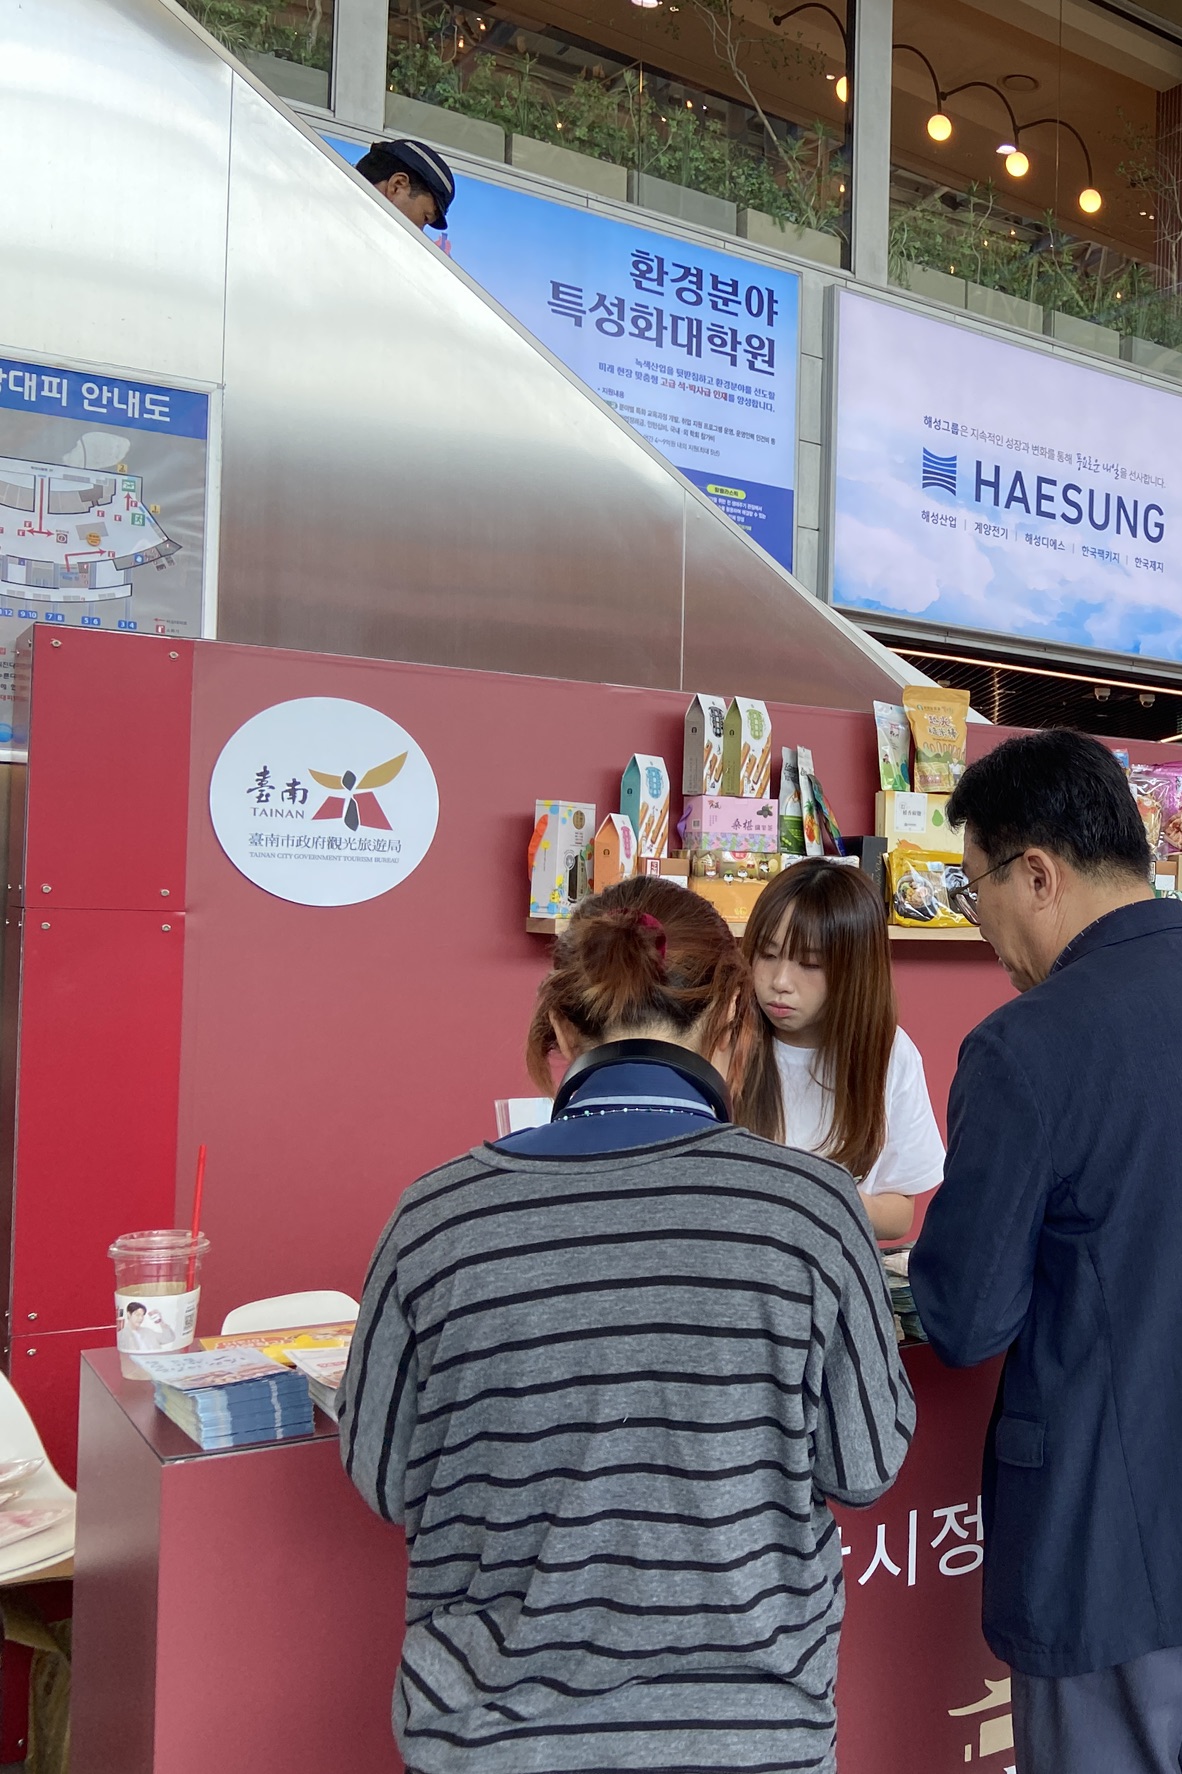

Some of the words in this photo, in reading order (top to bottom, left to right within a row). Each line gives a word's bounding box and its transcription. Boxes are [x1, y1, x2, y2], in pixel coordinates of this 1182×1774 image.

[630, 249, 778, 327] 환경분야
[547, 280, 775, 376] 특성화대학원
[81, 382, 171, 422] 안내도
[598, 362, 615, 374] 미래
[617, 366, 633, 378] 현장
[635, 371, 659, 385] 맞춤형
[660, 377, 676, 389] 고급
[678, 381, 711, 397] 석·박사급
[713, 389, 735, 403] 인재를
[737, 395, 775, 413] 양성합니다.
[602, 387, 625, 399] 지원내용
[635, 358, 674, 376] 녹색산업을
[676, 368, 714, 386] 뒷받침하고
[716, 378, 752, 395] 환경분야를
[754, 387, 775, 400] 선도할
[923, 414, 969, 438] 해성그룹은
[970, 427, 1004, 448] 지속적인
[1005, 436, 1030, 454] 성장과
[1031, 443, 1055, 461] 변화를
[1056, 450, 1073, 465] 통해
[1076, 451, 1101, 473] 풍요로운
[1102, 462, 1127, 481] 내일을
[1128, 469, 1167, 489] 선사합니다.
[974, 459, 1165, 544] HAESUNG
[920, 509, 957, 529] 해성산업
[974, 521, 1009, 540] 계양전기
[1024, 532, 1066, 551] 해성디에스
[1081, 545, 1120, 563] 한국팩키지
[1134, 556, 1164, 573] 한국제지
[247, 765, 308, 804] 臺南
[251, 806, 305, 819] TAINAN
[248, 832, 402, 853] 臺南市政府觀光旅遊局
[343, 855, 373, 863] TOURISM
[840, 1495, 984, 1587] 시정
